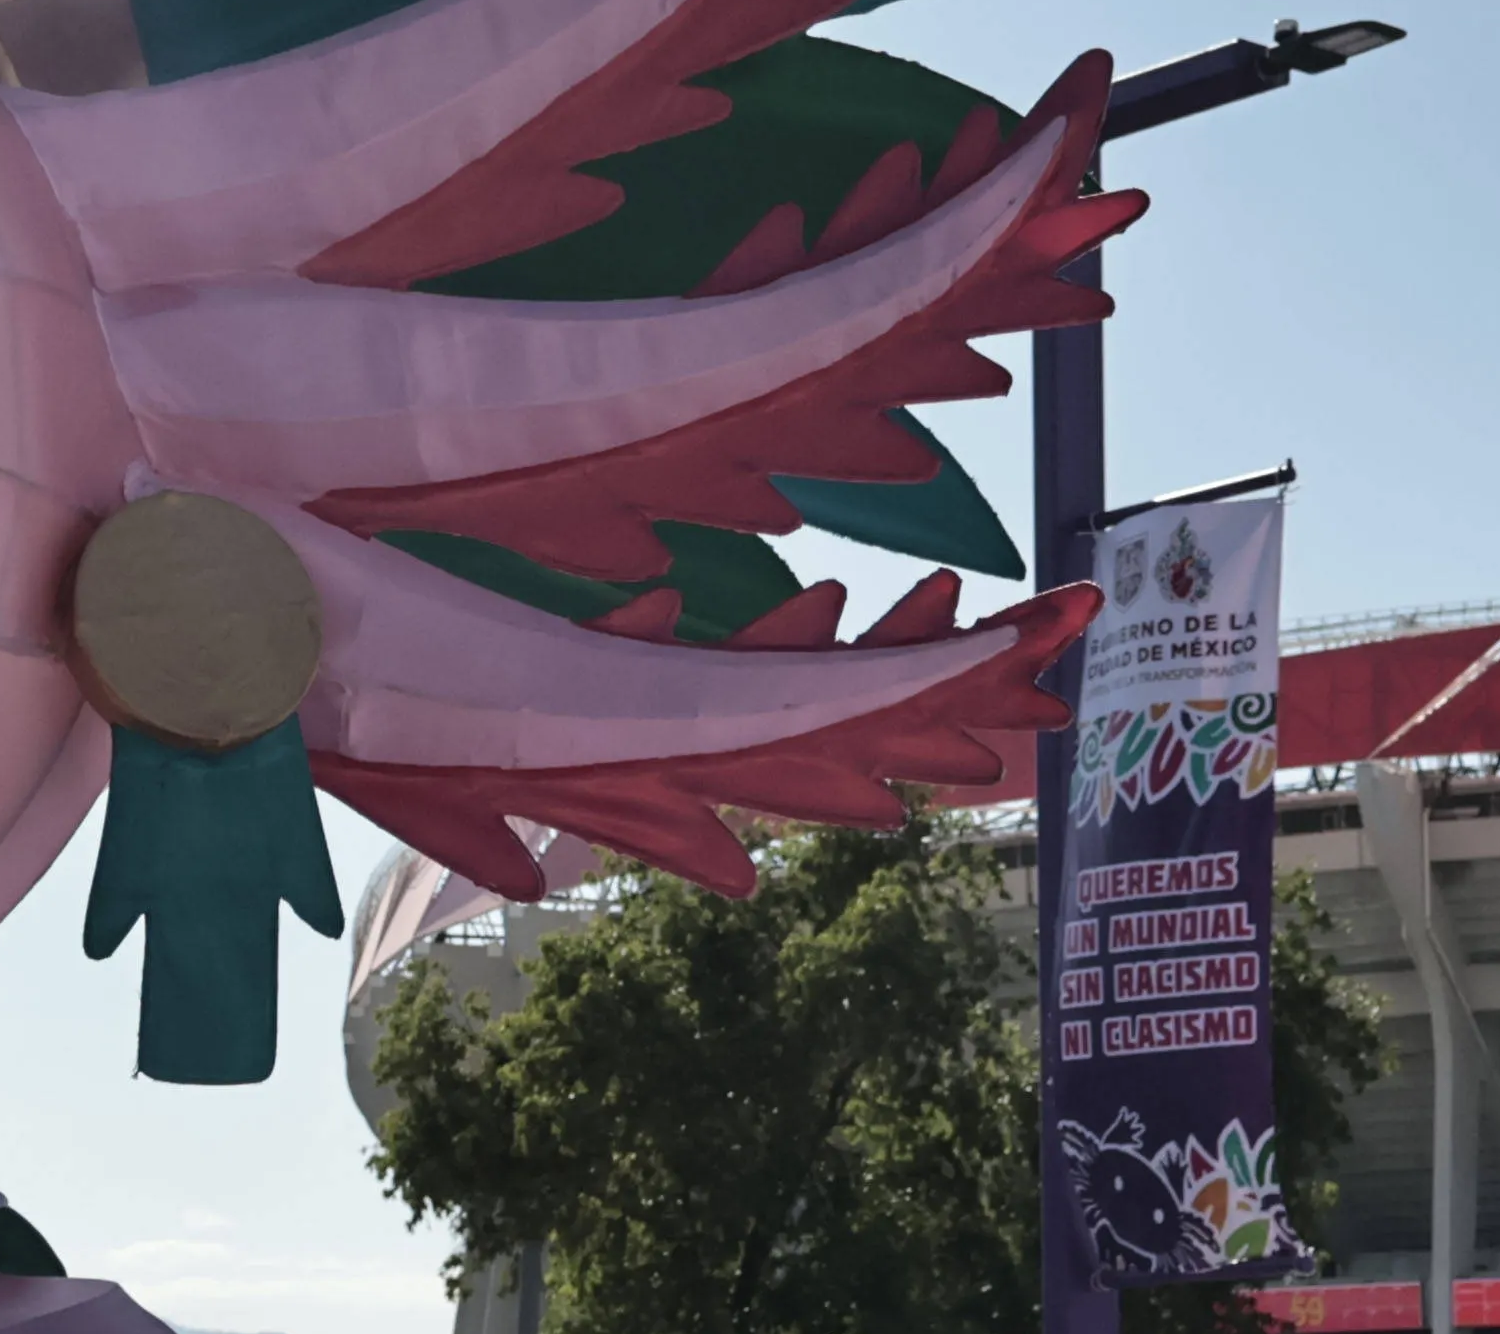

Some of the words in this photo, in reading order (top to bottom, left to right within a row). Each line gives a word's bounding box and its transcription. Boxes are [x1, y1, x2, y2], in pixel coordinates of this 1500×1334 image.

[1137, 644, 1165, 664] DE
[1170, 635, 1258, 660] MÉXICO
[1184, 614, 1218, 633] DE
[1229, 611, 1258, 630] LA
[1078, 851, 1239, 913] QUEREMOS
[1063, 918, 1099, 960] UN
[1108, 902, 1256, 954] MUNDIAL
[1059, 966, 1104, 1009] SIN
[1114, 952, 1260, 1003] RACISMO
[1061, 1020, 1092, 1061] NI
[1102, 1005, 1257, 1056] CLASISMO
[1289, 1294, 1325, 1328] 59
